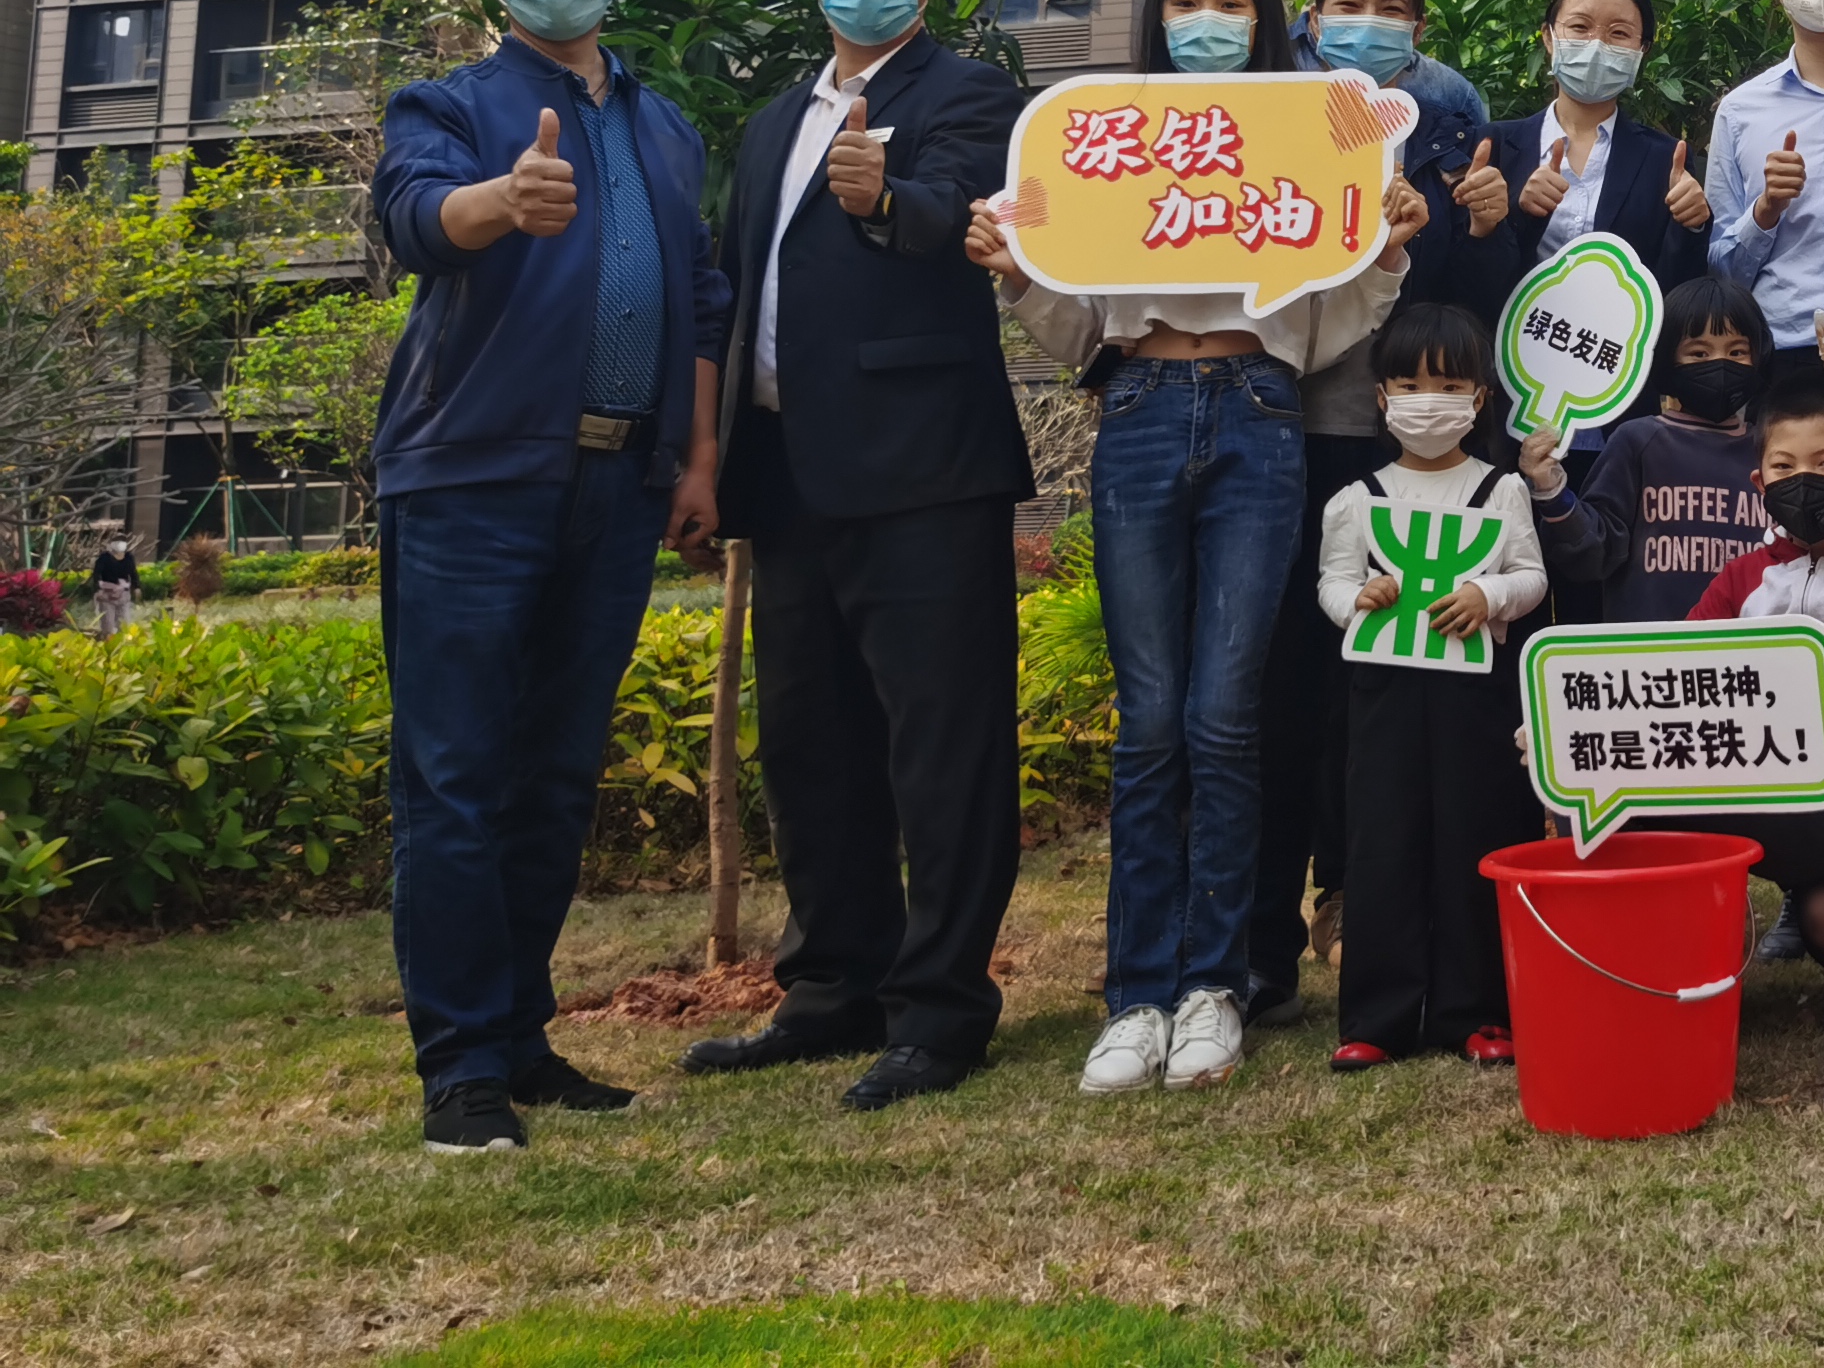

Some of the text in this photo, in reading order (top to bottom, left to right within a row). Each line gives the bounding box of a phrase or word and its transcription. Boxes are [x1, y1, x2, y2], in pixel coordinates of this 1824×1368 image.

[1062, 104, 1244, 182] 深铁
[1523, 307, 1624, 374] 绿色发展
[1643, 485, 1730, 524] COFFEE
